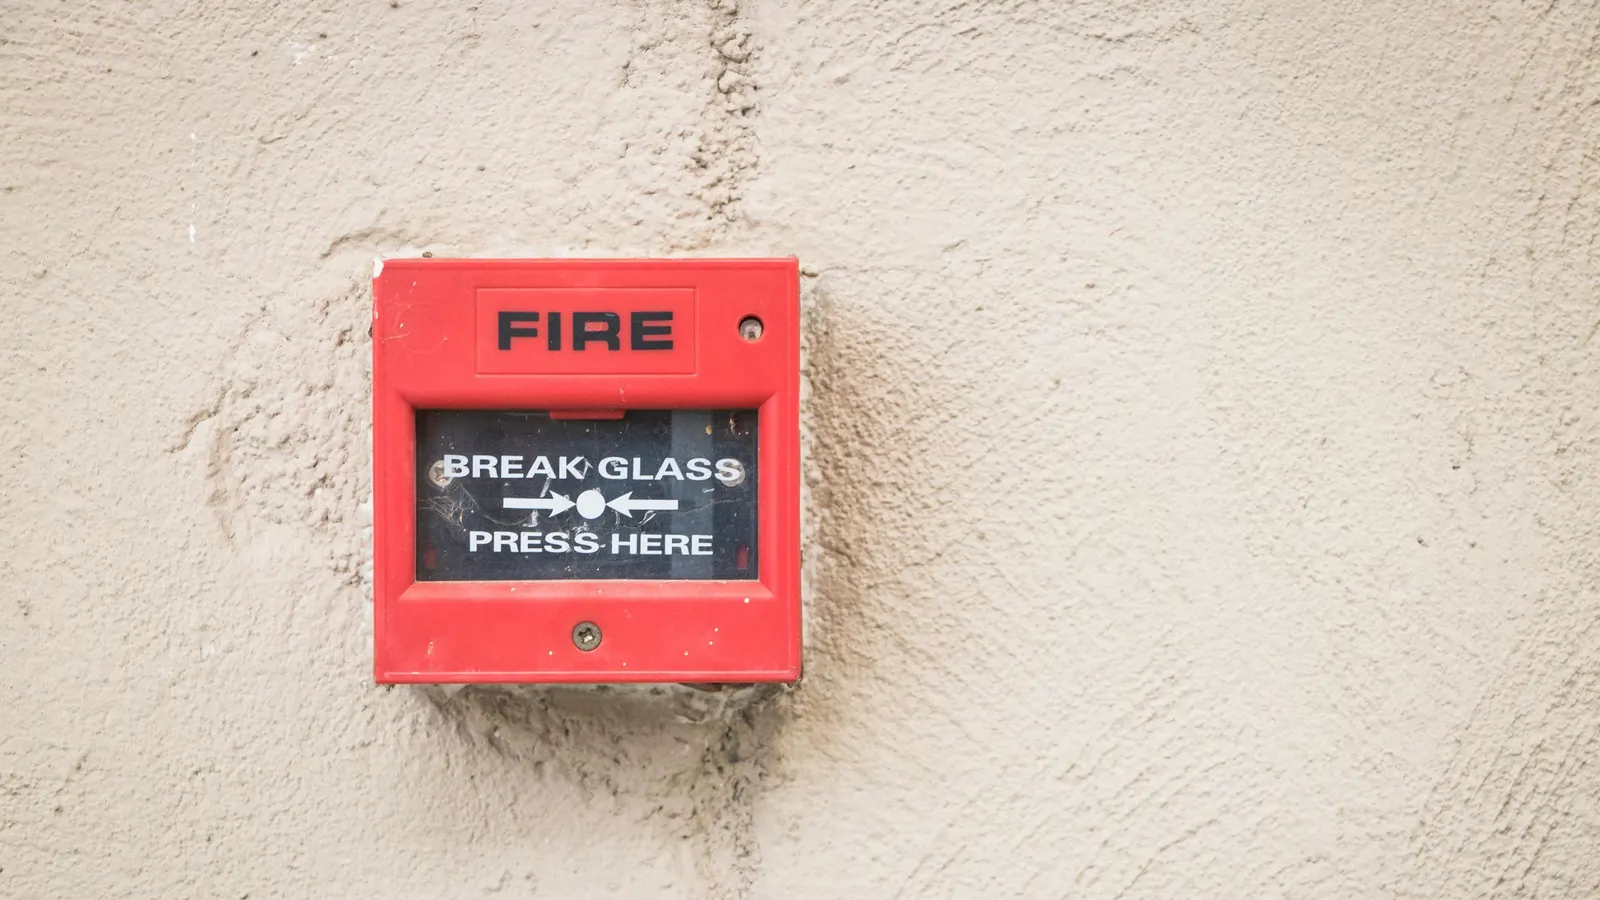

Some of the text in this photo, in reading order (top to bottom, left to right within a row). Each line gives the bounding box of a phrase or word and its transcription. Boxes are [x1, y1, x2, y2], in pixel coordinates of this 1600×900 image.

[497, 311, 674, 351] FIRE
[443, 454, 742, 481] BREAK GLASS
[469, 530, 714, 556] PRESS HERE
